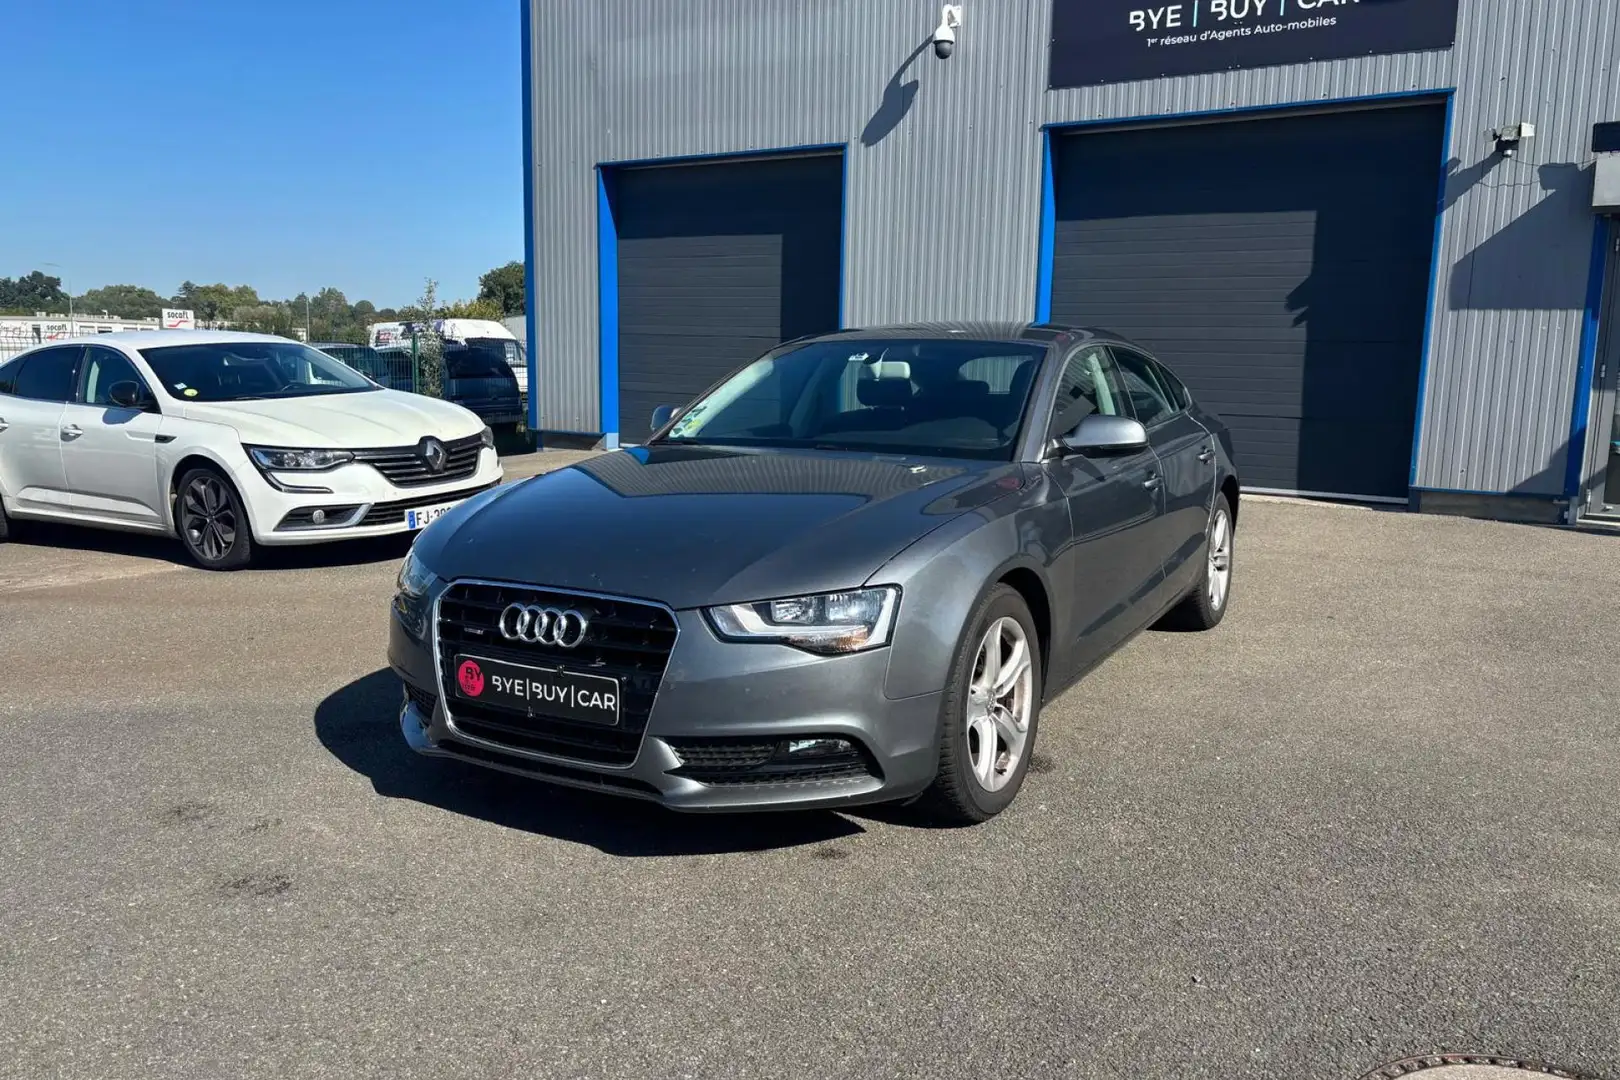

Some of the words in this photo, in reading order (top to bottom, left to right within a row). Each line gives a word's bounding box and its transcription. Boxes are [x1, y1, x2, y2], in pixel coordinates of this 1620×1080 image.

[1129, 4, 1183, 32] BYE
[1210, 0, 1267, 21] BUY
[1160, 34, 1197, 46] réseau
[1199, 26, 1251, 41] d'Agents
[1253, 16, 1337, 35] Auto-mobiles
[416, 506, 452, 527] FJ-
[577, 689, 616, 711] CAR
